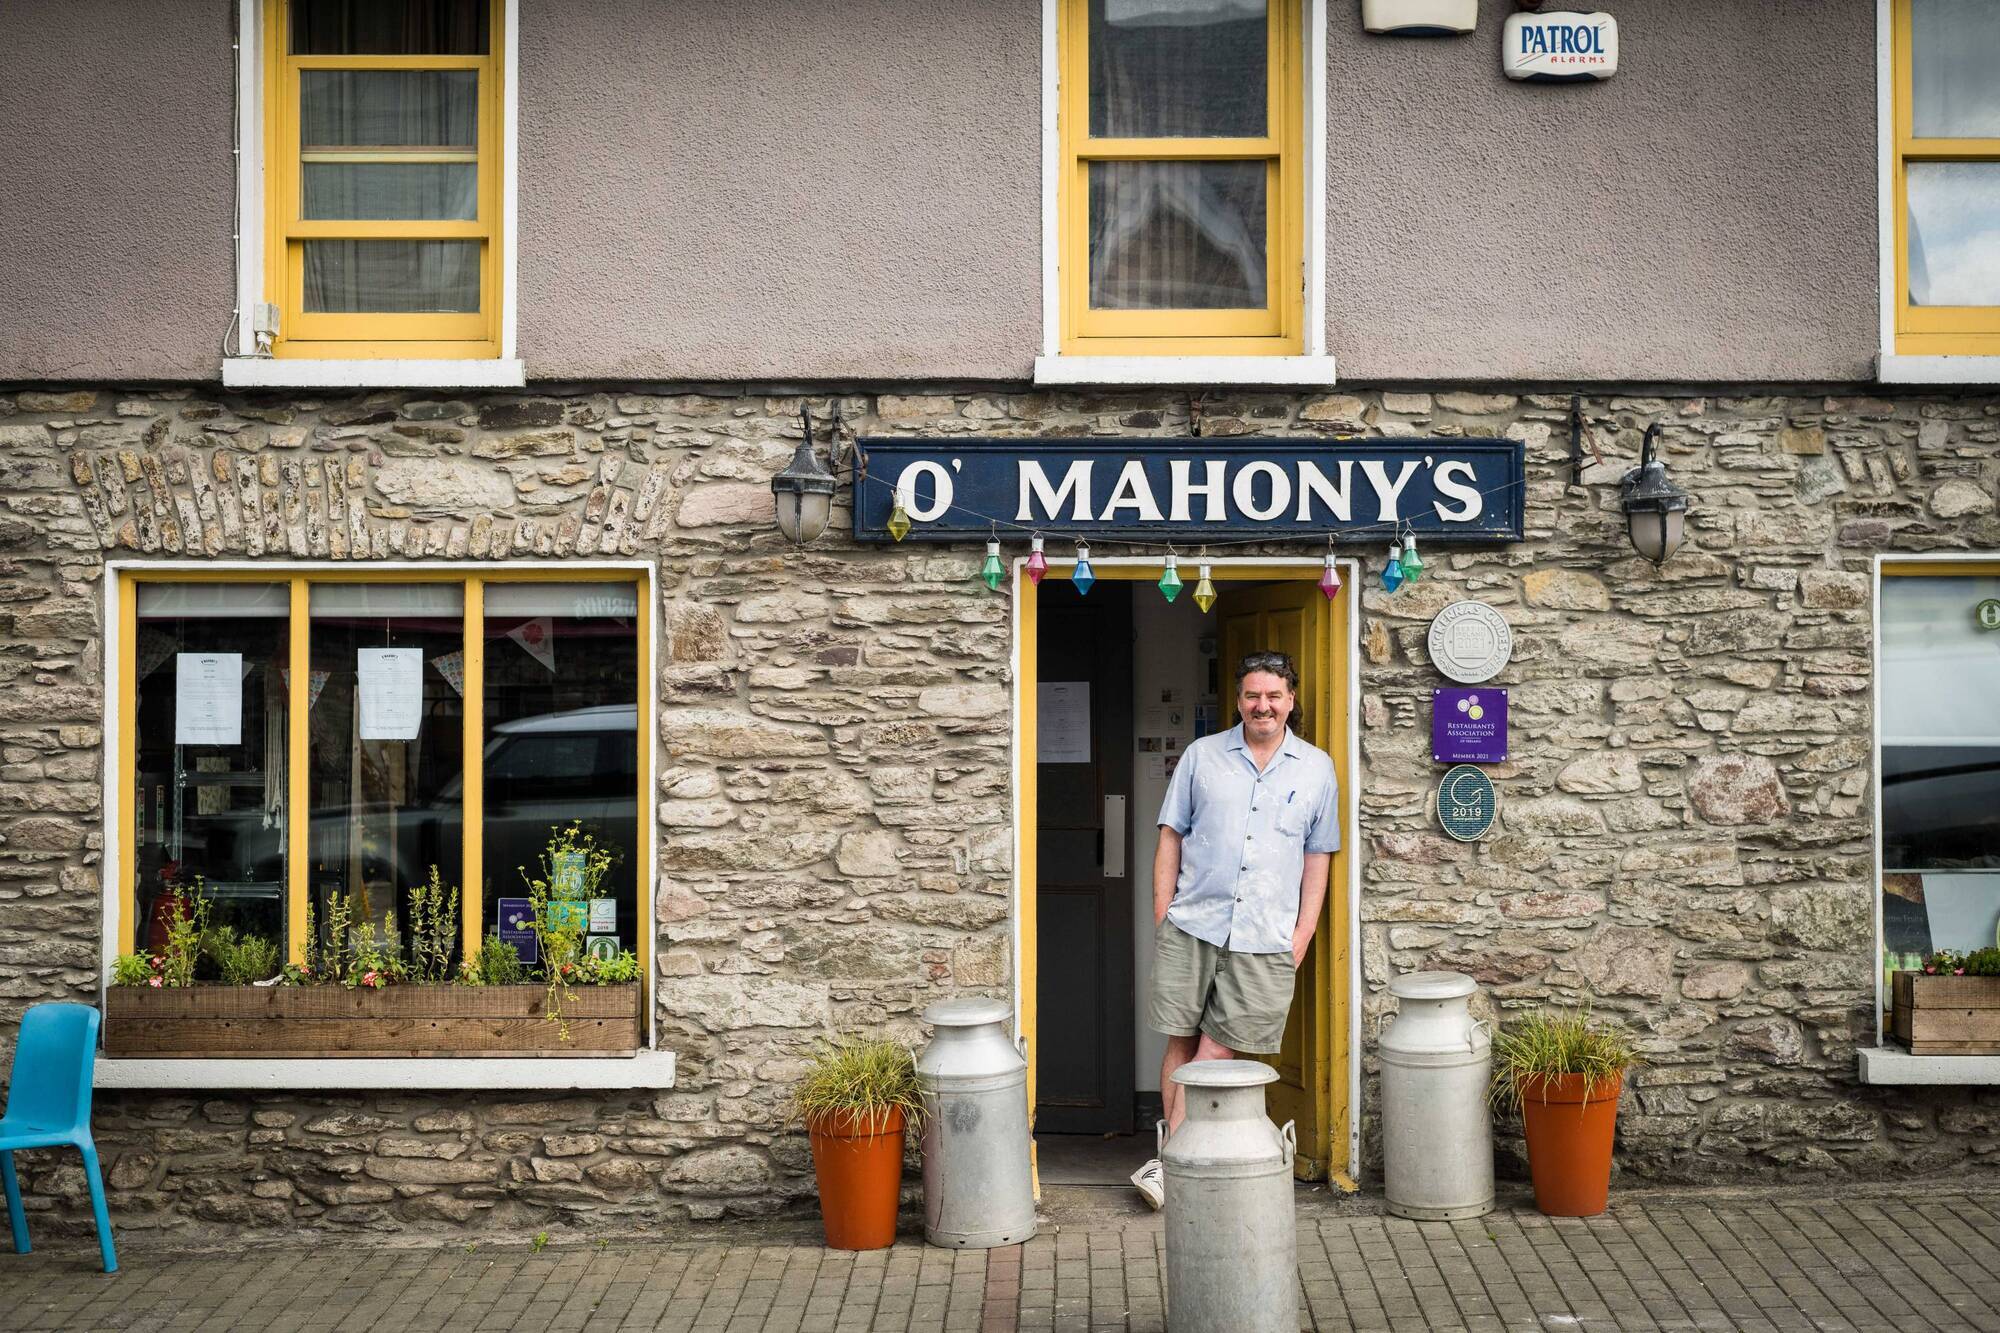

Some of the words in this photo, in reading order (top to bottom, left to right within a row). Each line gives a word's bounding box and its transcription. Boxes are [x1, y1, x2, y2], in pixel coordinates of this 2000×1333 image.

[1521, 25, 1604, 54] PATROL
[1551, 56, 1605, 64] ALARMS
[896, 458, 962, 522] O'
[1014, 455, 1483, 522] MAHONY'S
[1484, 610, 1509, 653] GUIDES
[1452, 807, 1482, 817] 2019
